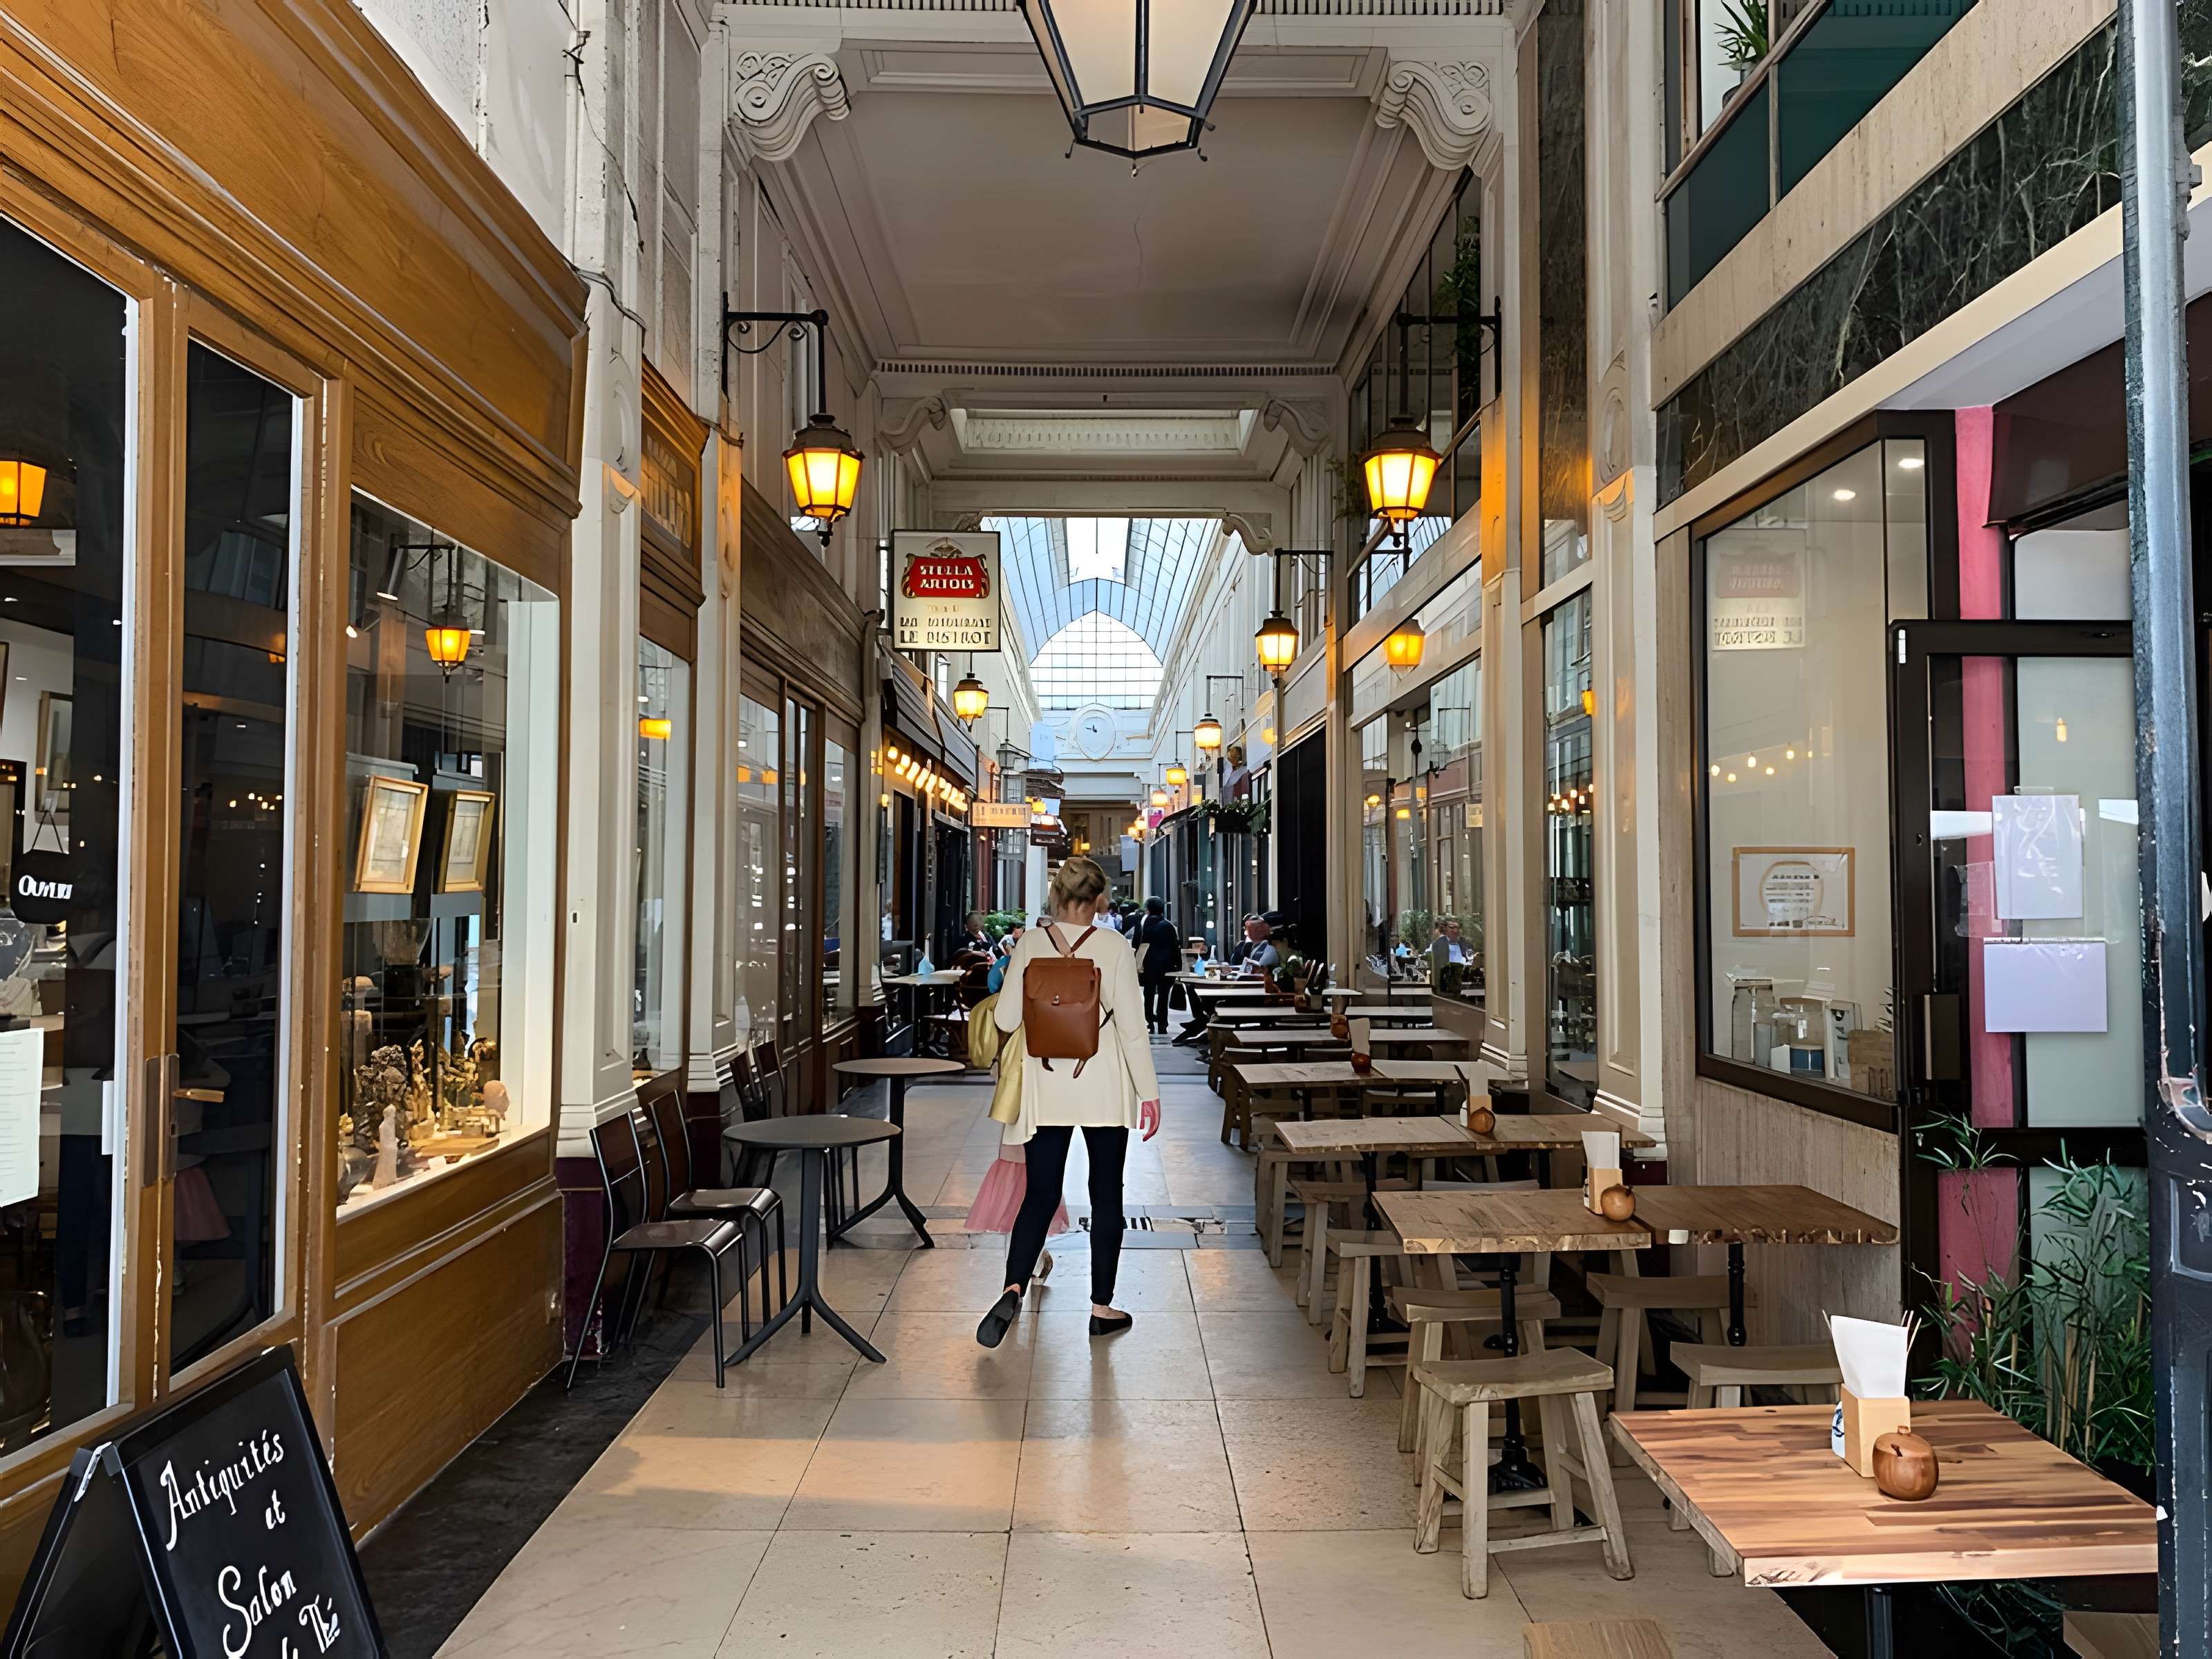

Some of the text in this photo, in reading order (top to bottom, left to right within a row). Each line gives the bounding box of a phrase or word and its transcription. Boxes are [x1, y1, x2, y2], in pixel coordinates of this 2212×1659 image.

[160, 1429, 285, 1551] Antiquités
[265, 1489, 285, 1530] et
[218, 1565, 297, 1659] Salon
